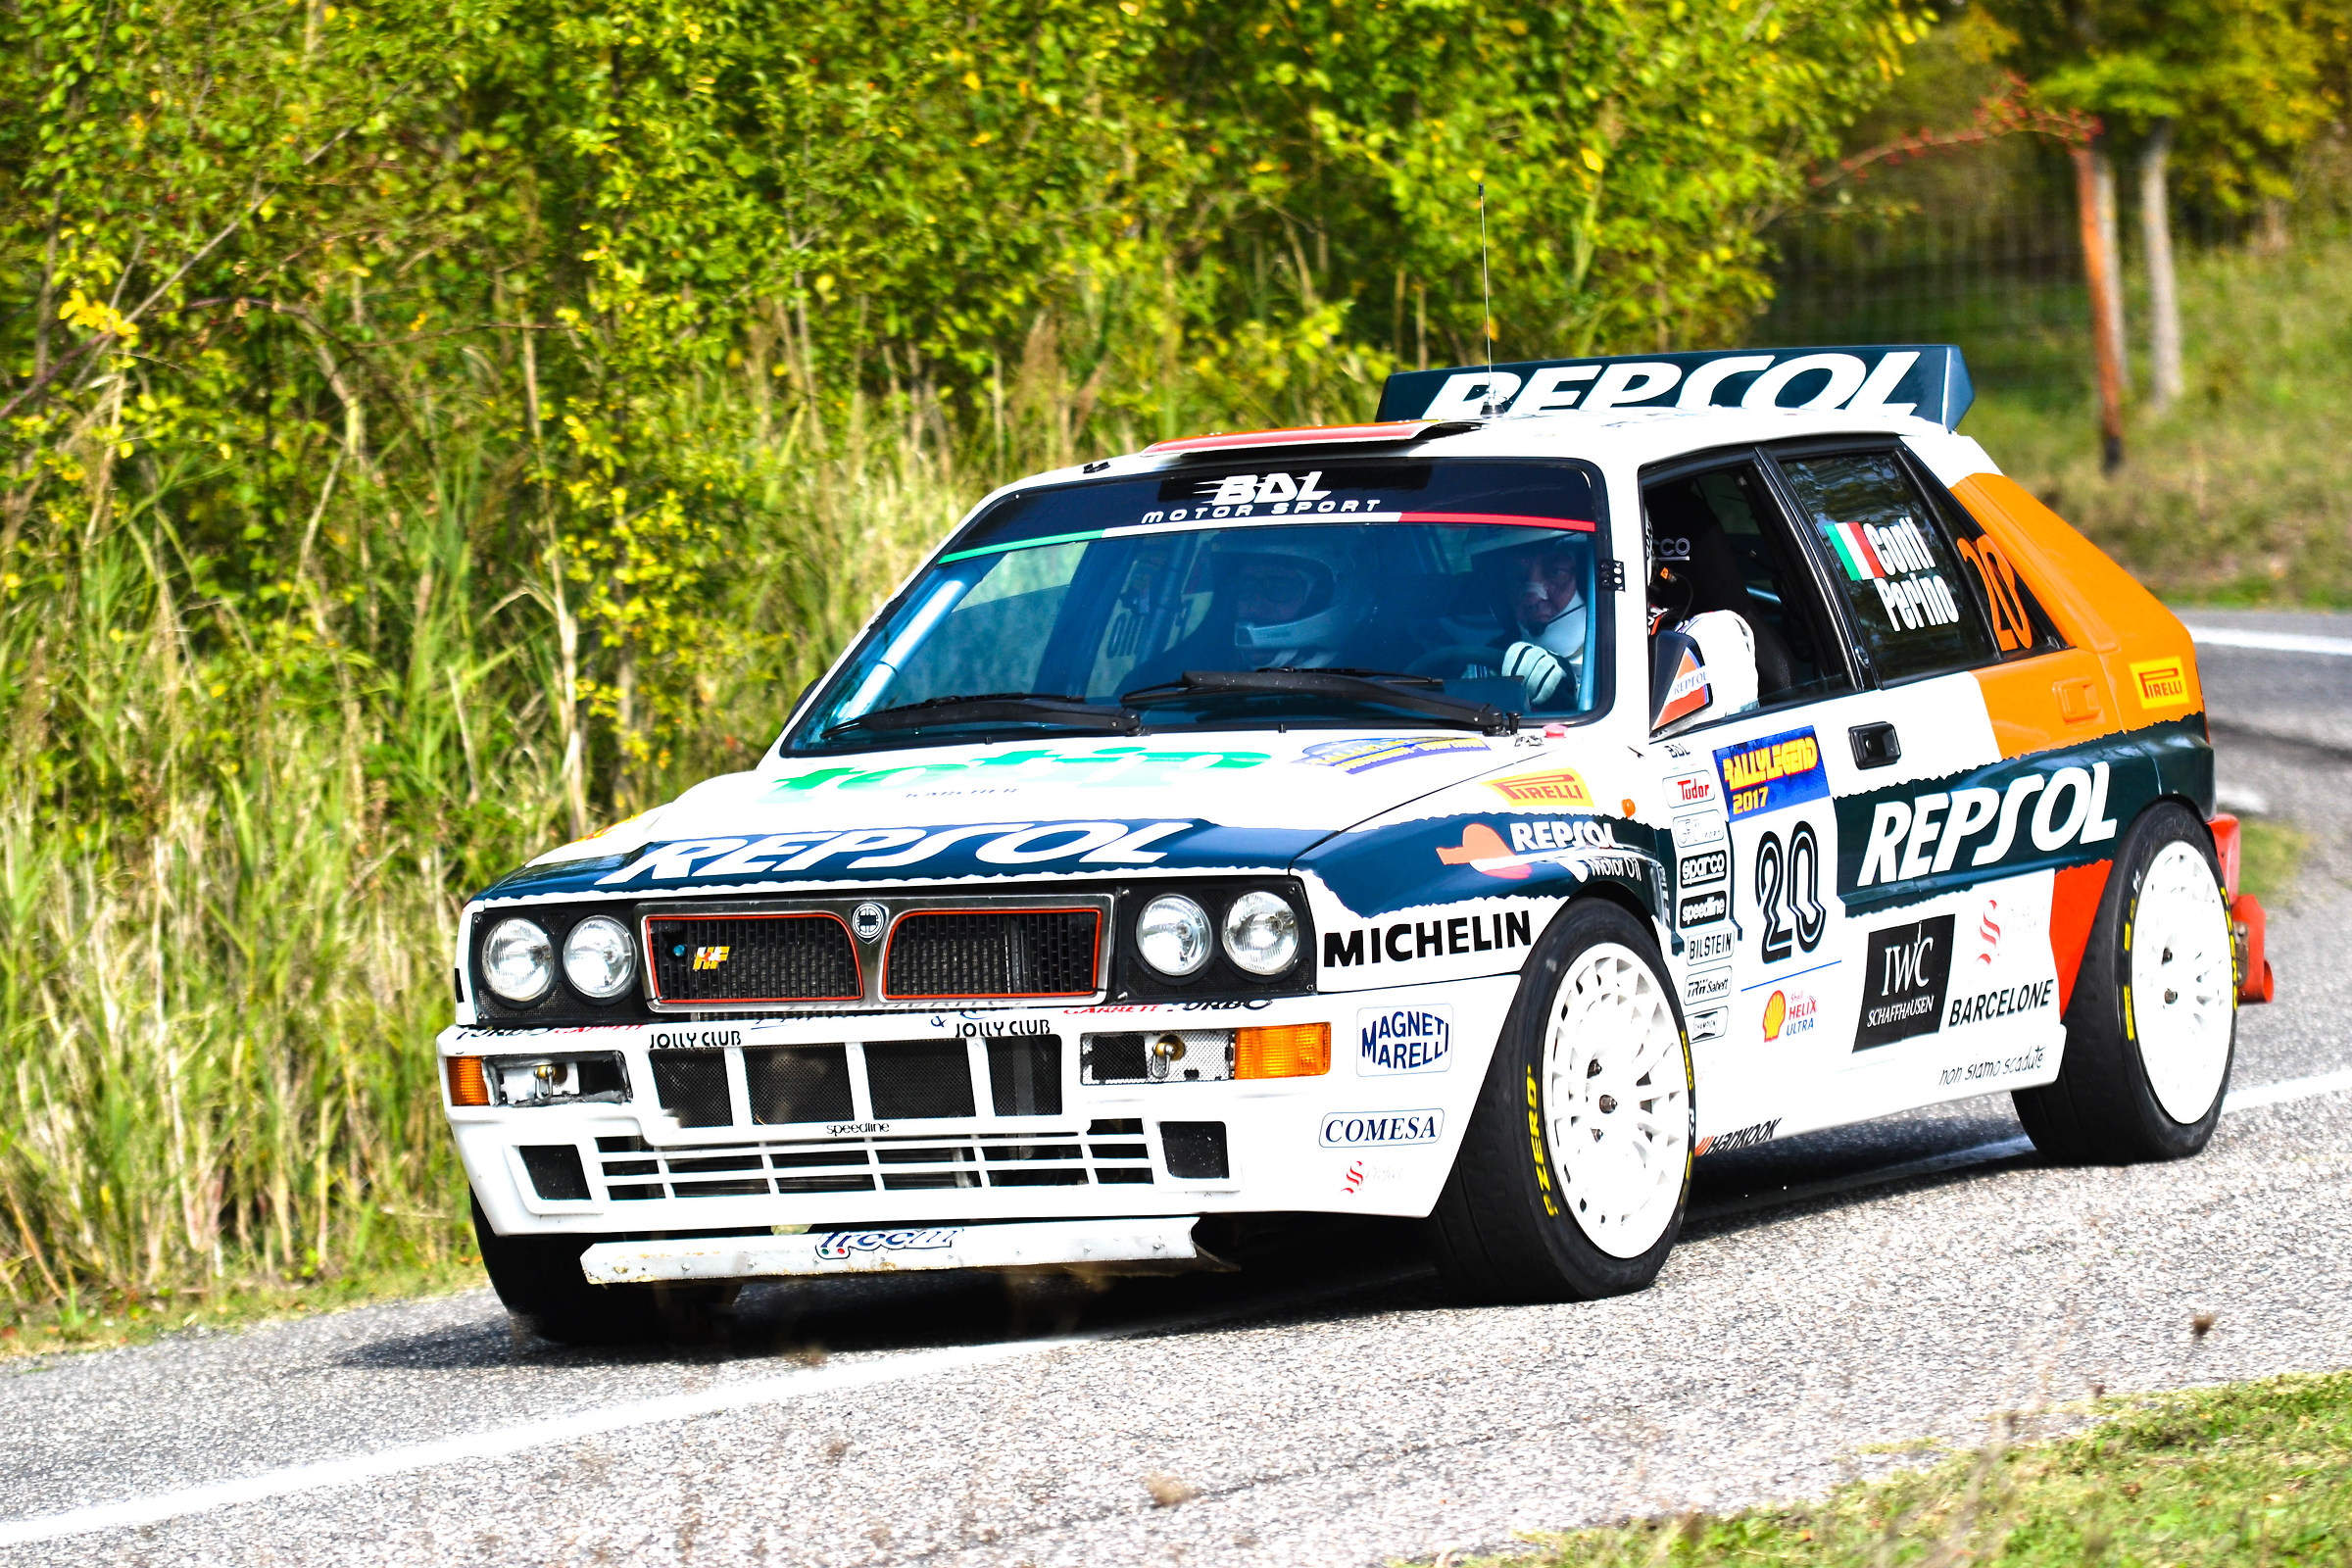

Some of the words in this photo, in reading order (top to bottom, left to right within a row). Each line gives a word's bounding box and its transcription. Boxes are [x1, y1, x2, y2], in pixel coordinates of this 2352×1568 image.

[1141, 504, 1253, 524] MOTOR
[1270, 499, 1381, 515] SPORT
[1874, 573, 1960, 632] Perino
[1956, 532, 2034, 653] 20
[2138, 666, 2183, 700] PIRELLI
[1494, 773, 1584, 802] PIRELLI
[1677, 778, 1710, 801] Tudor
[1733, 786, 1769, 815] 2017
[1509, 821, 1624, 852] REPSOL
[1856, 761, 2118, 887] REPSOL
[594, 821, 1194, 885] REPSOL
[1682, 853, 1726, 881] sparco
[1585, 858, 1624, 877] Motor
[1623, 858, 1642, 882] Oil
[1754, 821, 1827, 965] 20
[1682, 896, 1726, 925] speedline
[1323, 910, 1532, 968] MICHELIN
[1689, 933, 1733, 959] BILSTEIN
[1882, 936, 1935, 997] IWC
[1788, 996, 1817, 1021] HELIX
[1866, 995, 1936, 1028] SCHAFFHAUSEN
[1948, 979, 2054, 1028] BARCELONE
[649, 1032, 698, 1049] JOLLY
[702, 1030, 742, 1048] CLUB
[956, 1022, 1004, 1038] JOLLY
[1008, 1019, 1051, 1036] CLUB
[1786, 1017, 1815, 1037] ULTRA
[1938, 1065, 1963, 1087] non
[826, 1122, 890, 1137] speedline
[1324, 1116, 1437, 1143] COMESA
[1526, 1075, 1551, 1193] ZERO
